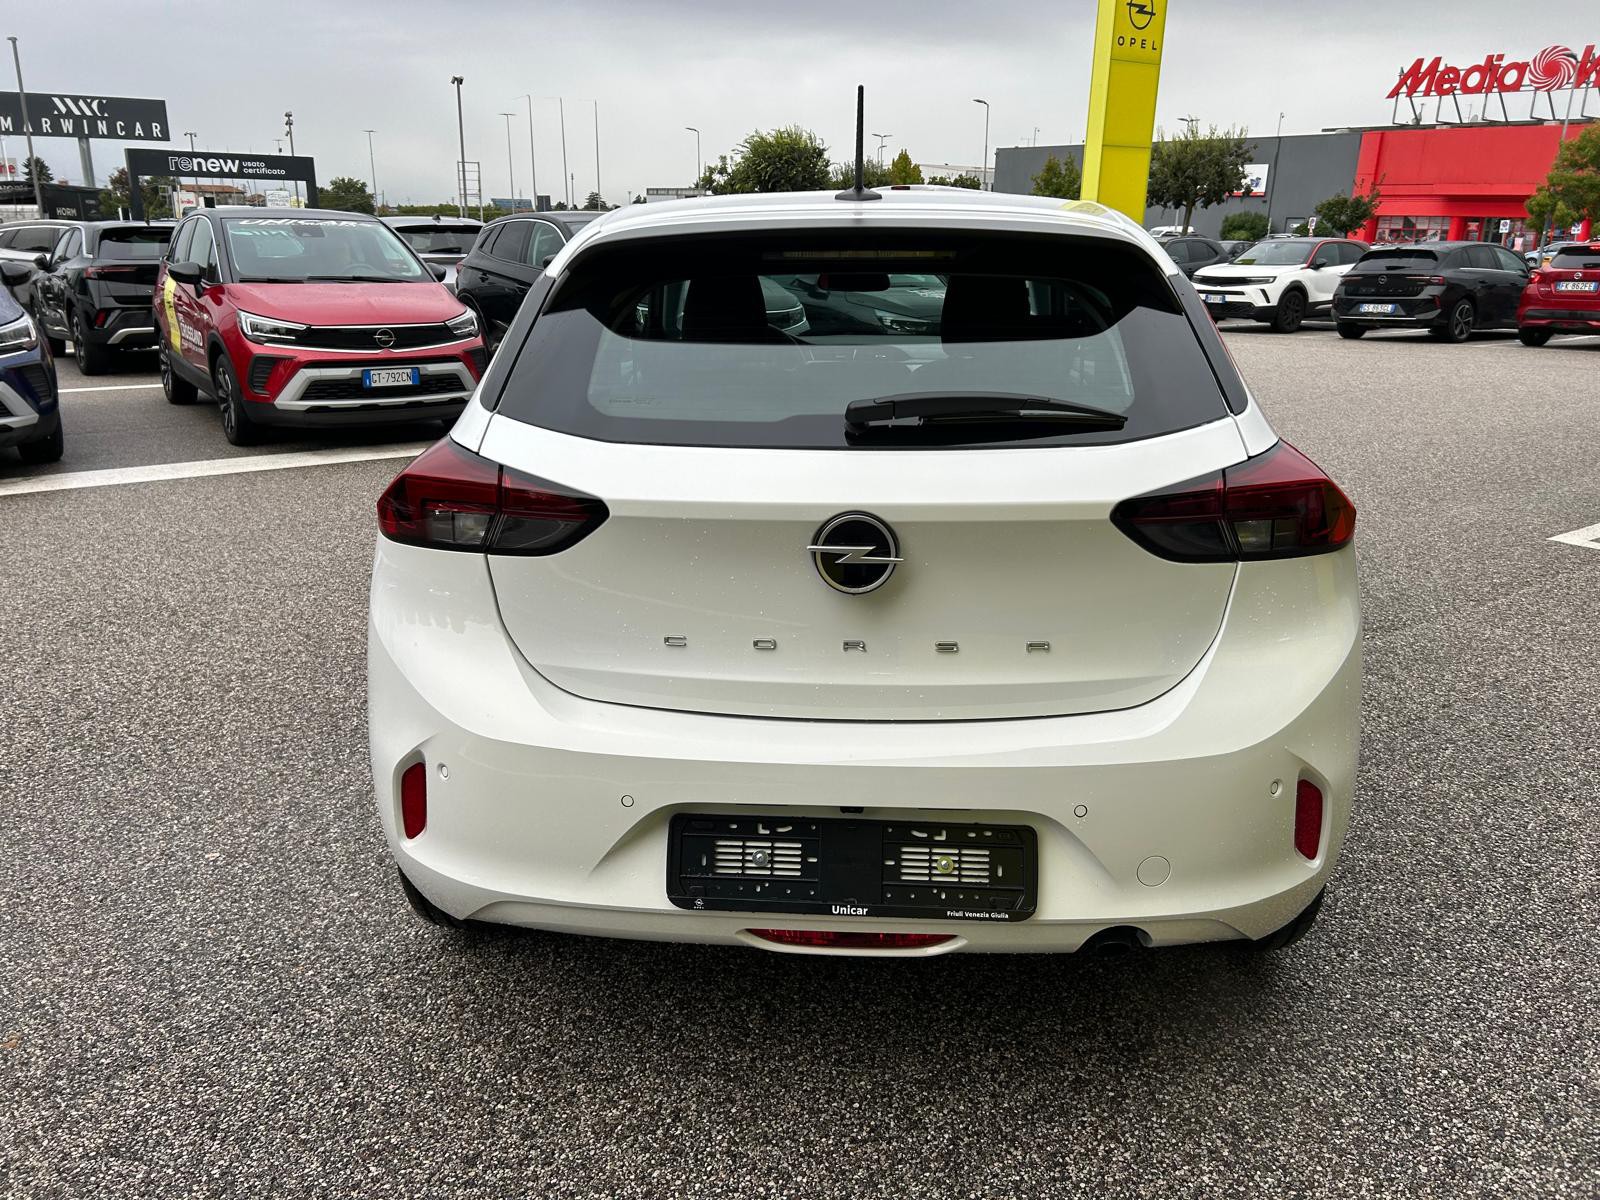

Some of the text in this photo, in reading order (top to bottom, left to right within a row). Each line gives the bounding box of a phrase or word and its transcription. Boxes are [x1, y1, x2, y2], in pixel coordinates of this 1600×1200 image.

[1117, 36, 1157, 51] OPEL
[168, 156, 240, 173] renew
[243, 167, 286, 175] certificato
[663, 634, 1051, 654] CORSA
[831, 904, 868, 916] Unicar
[947, 910, 963, 918] Friuli
[965, 911, 989, 919] Venezia
